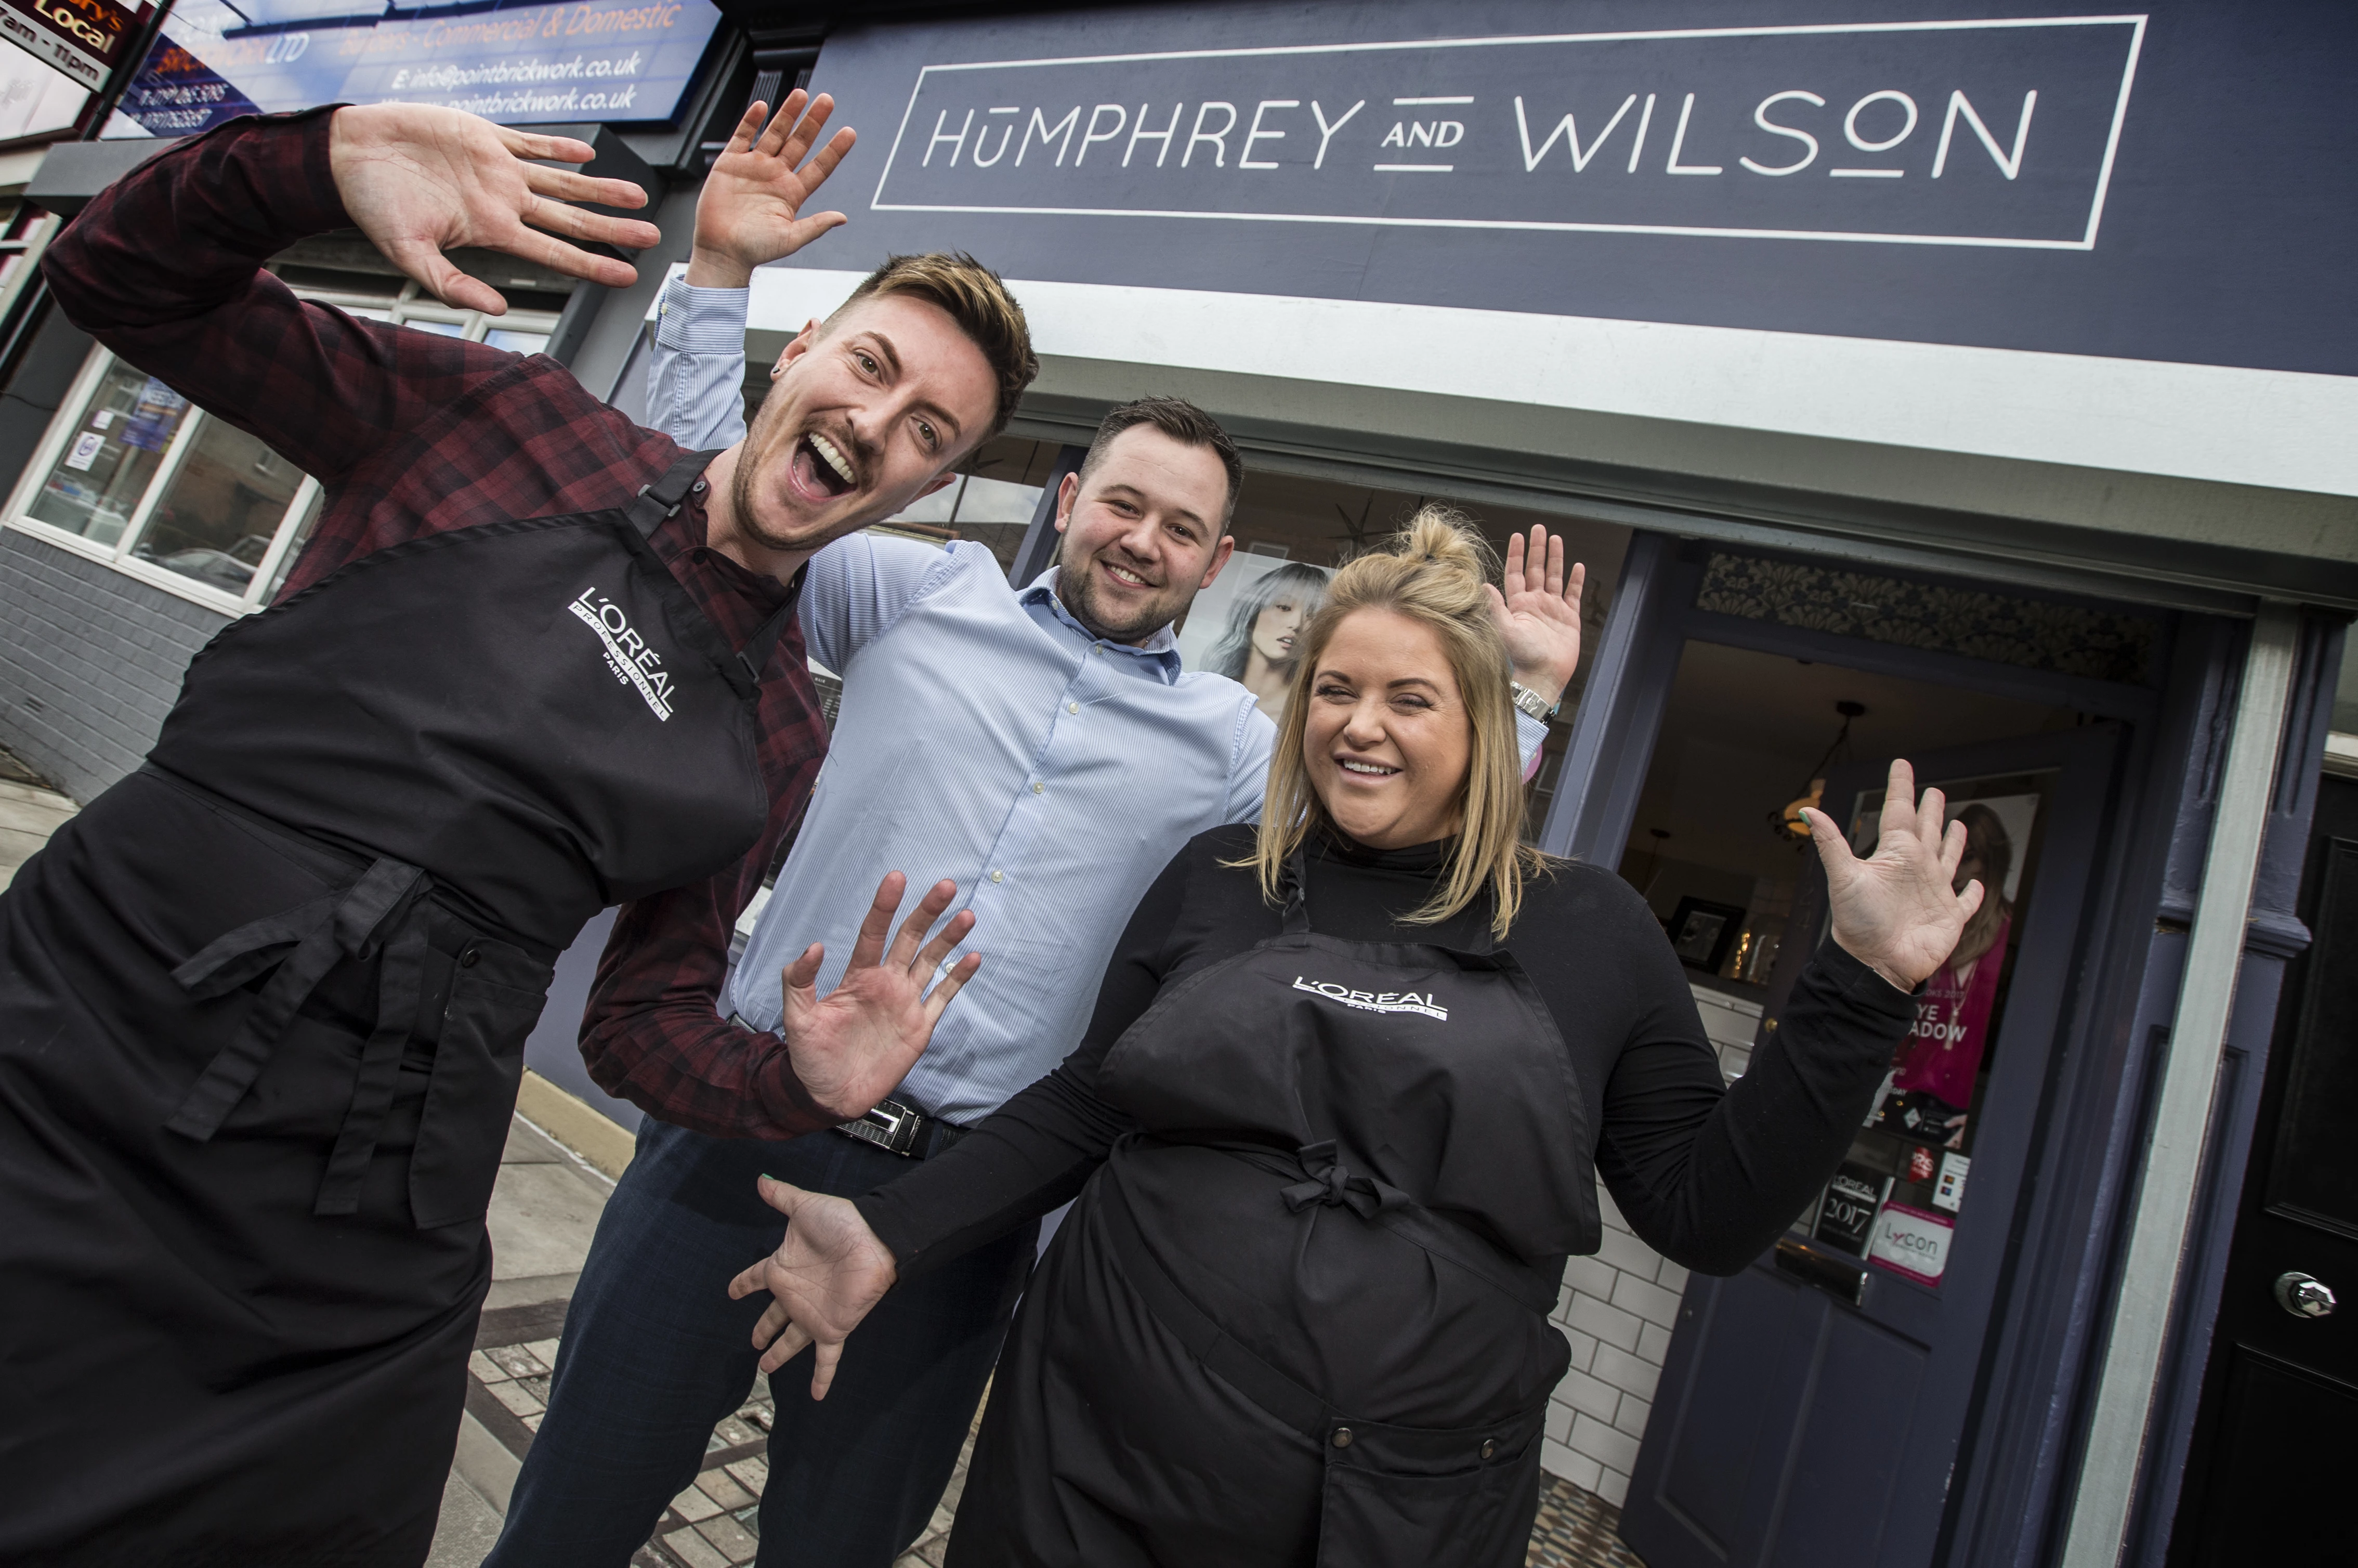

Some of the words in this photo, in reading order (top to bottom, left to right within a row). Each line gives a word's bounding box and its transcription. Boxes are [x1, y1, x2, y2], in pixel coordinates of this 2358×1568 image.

[33, 0, 116, 54] Local
[423, 6, 547, 48] Commercial
[542, 6, 566, 38] &
[565, 0, 682, 36] Domestic
[266, 32, 310, 64] LTD
[1381, 120, 1465, 148] AND
[1513, 88, 2037, 180] WILSON
[572, 605, 665, 720] PROFESSIONNEL
[602, 651, 630, 685] PARIS
[1925, 988, 1943, 998] OKS
[1915, 1003, 1940, 1021] YE
[1907, 1020, 1968, 1043] ADOW
[1824, 1197, 1871, 1234] 2017
